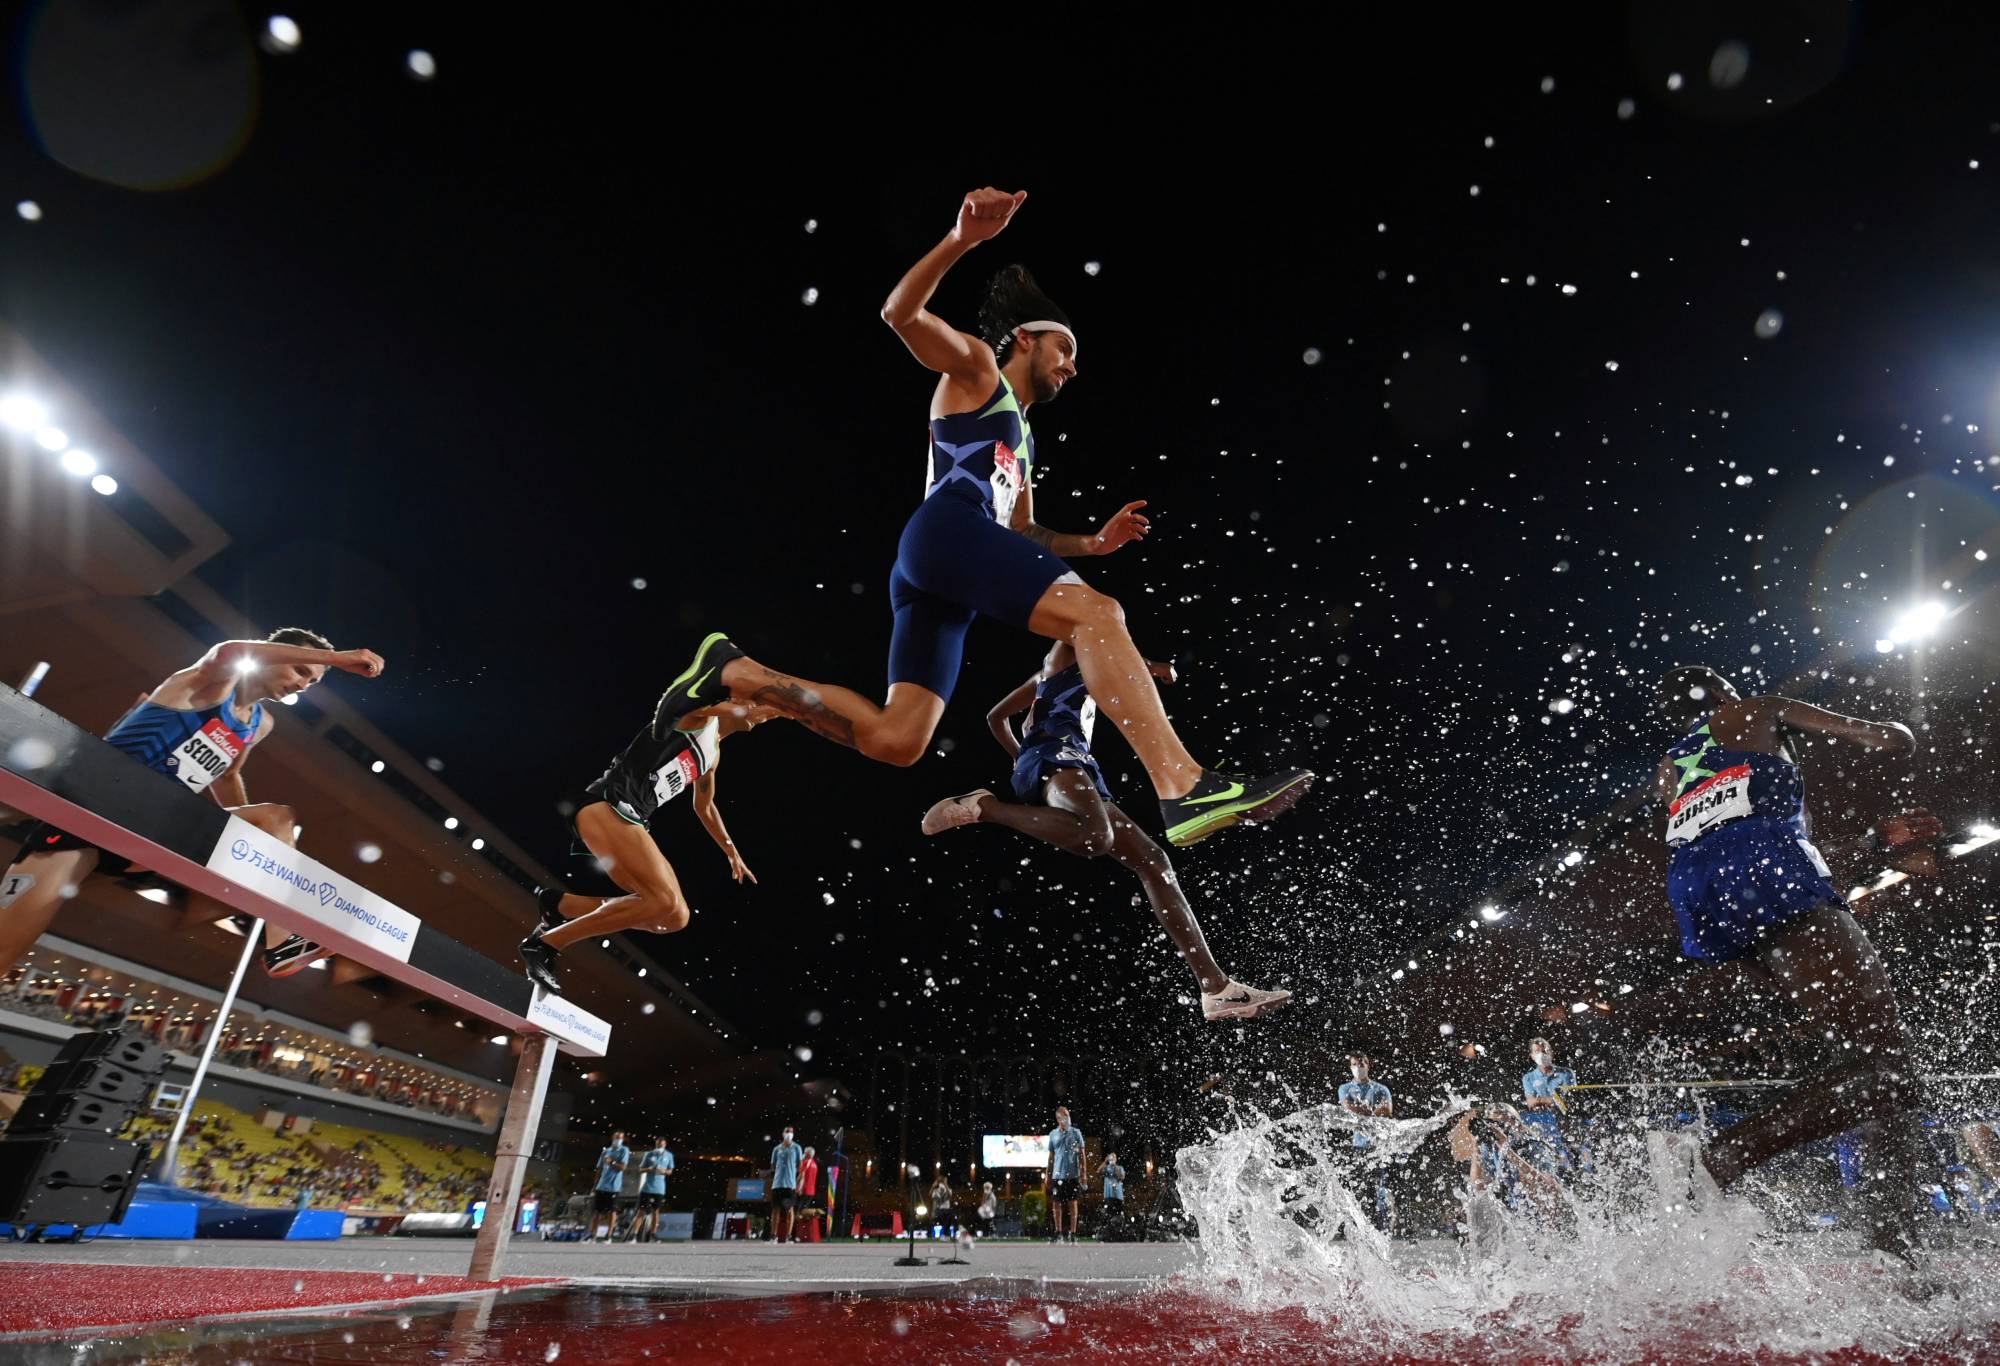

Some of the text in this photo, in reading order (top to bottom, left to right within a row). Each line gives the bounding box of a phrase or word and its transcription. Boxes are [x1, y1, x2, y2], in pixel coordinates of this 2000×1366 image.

[276, 864, 317, 896] WANDA
[334, 897, 376, 926] DIAMOND
[376, 919, 409, 943] LEAGUE
